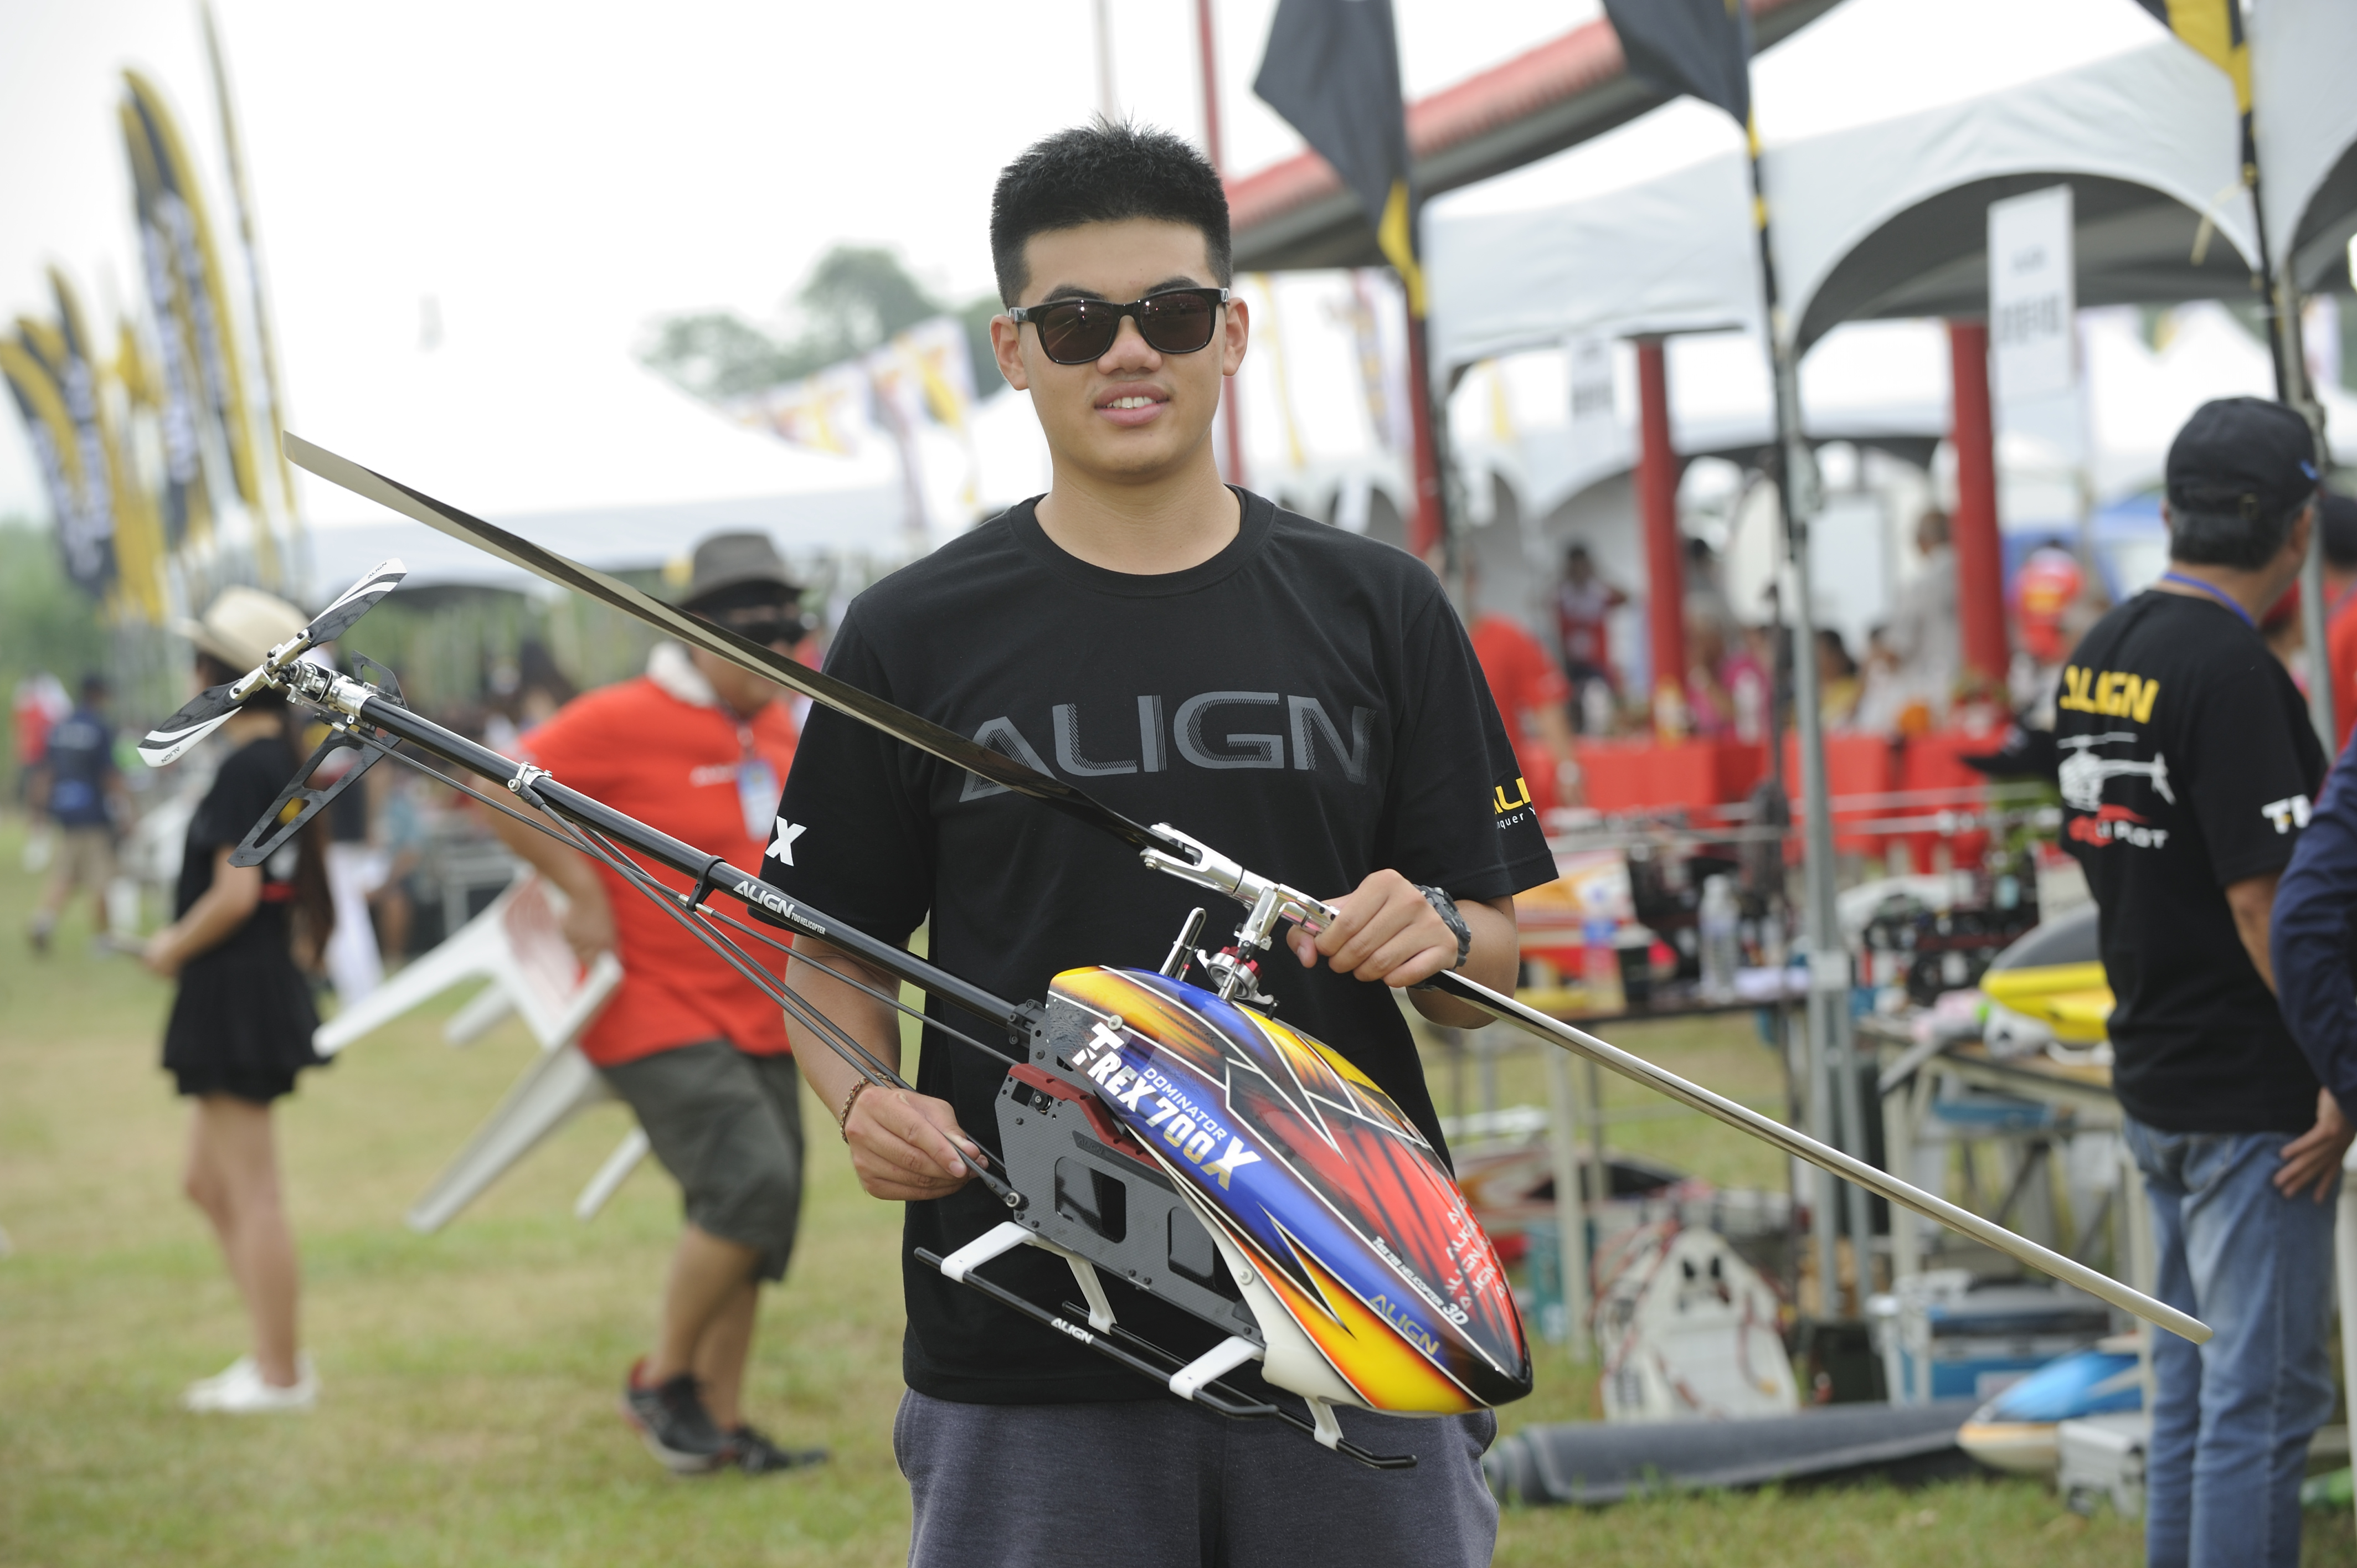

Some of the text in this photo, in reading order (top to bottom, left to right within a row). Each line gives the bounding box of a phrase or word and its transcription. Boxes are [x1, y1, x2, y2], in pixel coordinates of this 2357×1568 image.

[367, 561, 387, 579] ALIGN
[161, 746, 180, 764] ALIGN
[959, 690, 1377, 803] ALIGN
[765, 815, 807, 867] X
[733, 880, 826, 935] ALIGN 700 HELICOPTER
[1072, 1022, 1156, 1112] T-REX
[1143, 1067, 1228, 1141] DOMINATOR
[1077, 1138, 1105, 1154] ALIGN
[1445, 1218, 1478, 1261] ALIGN
[1398, 1263, 1445, 1307] HELICOPTER
[1442, 1302, 1469, 1325] 3D
[1444, 1247, 1483, 1297] ALIGN
[1051, 1318, 1094, 1344] ALIGN
[1370, 1293, 1440, 1356] ALIGN
